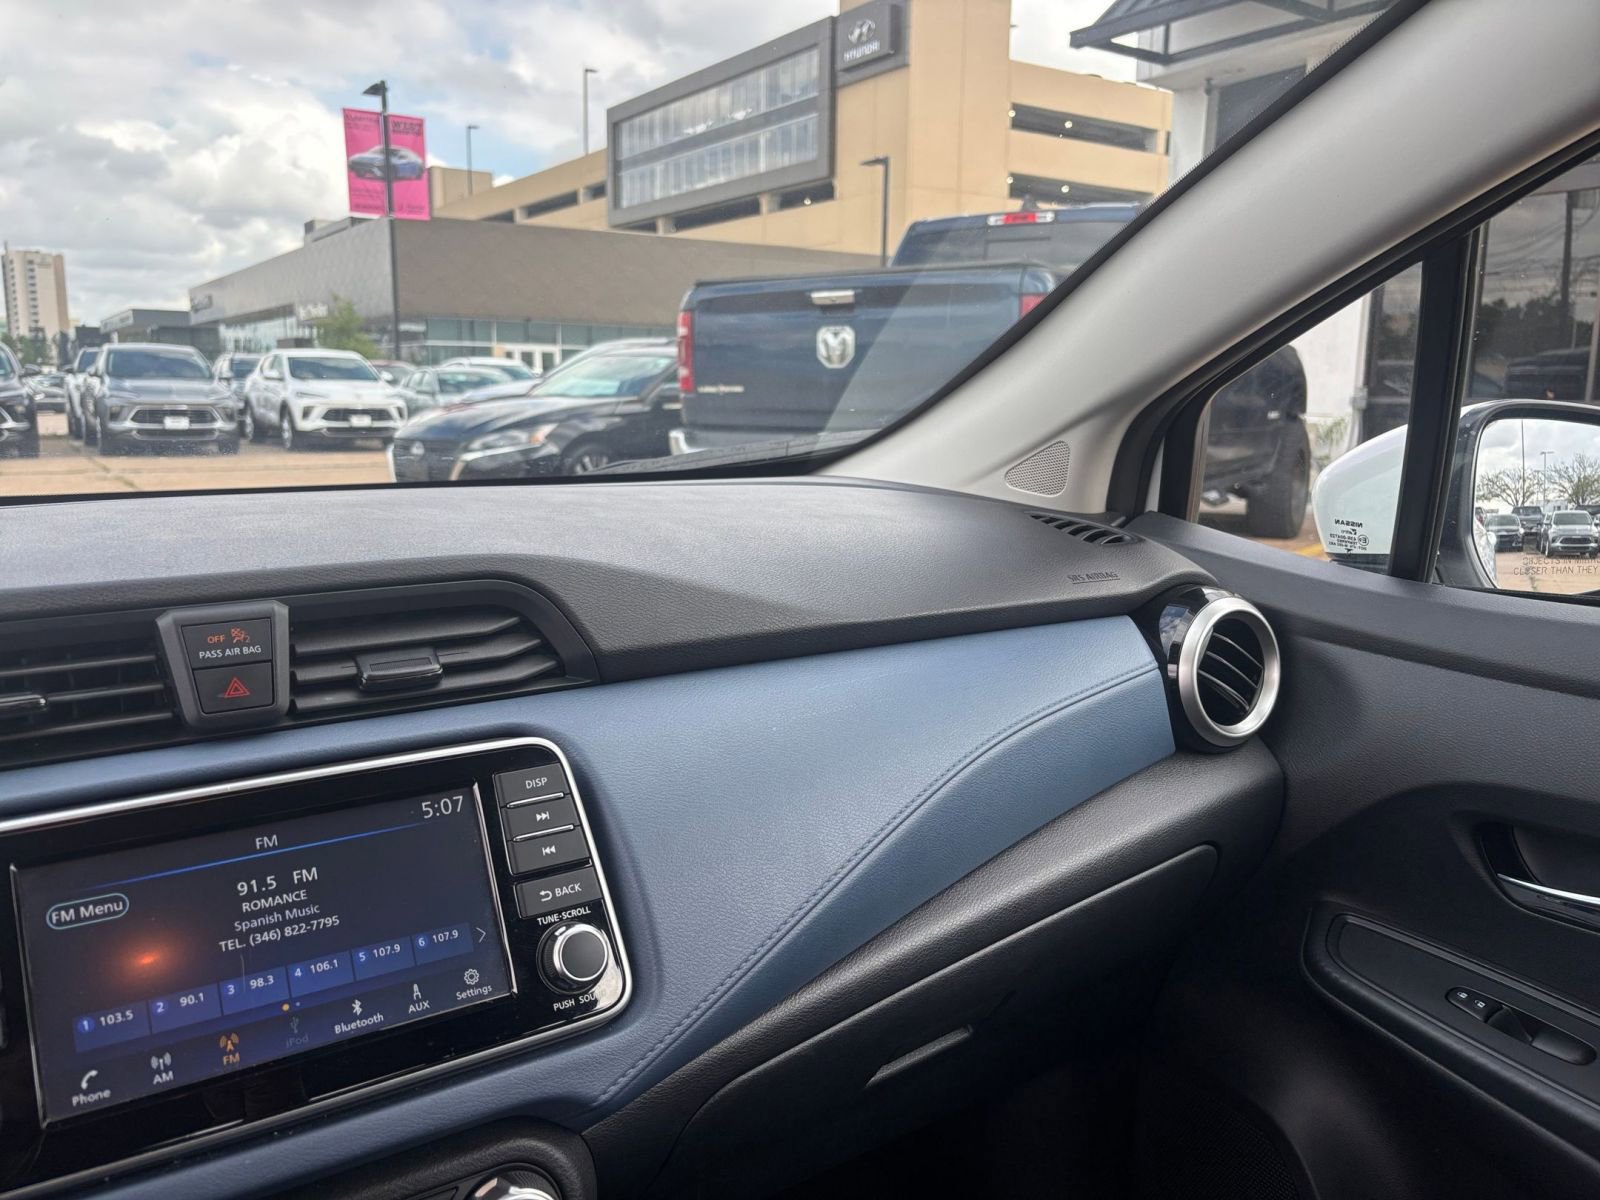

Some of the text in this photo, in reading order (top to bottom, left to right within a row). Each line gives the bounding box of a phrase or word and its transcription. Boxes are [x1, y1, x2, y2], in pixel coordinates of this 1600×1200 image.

[843, 40, 880, 62] HYUNDAI
[1523, 556, 1561, 566] OBJECTS
[1067, 571, 1119, 582] SRS AIRBAG
[1513, 565, 1598, 576] CLOSER THAN THEY
[207, 635, 225, 644] OFF
[199, 645, 262, 659] PASS AIR BAG
[525, 776, 548, 789] DISP
[421, 795, 464, 819] 5:07
[255, 834, 279, 850] FM
[237, 866, 319, 897] 91.5 FM
[555, 882, 582, 898] BACK
[242, 889, 308, 913] ROMANCE
[51, 899, 124, 924] FM Menu
[234, 903, 321, 933] Spanish Music
[218, 914, 340, 953] TEL. (346) 822-7795
[418, 930, 459, 947] 6 107.9
[359, 944, 401, 962] 5 107.9
[294, 960, 339, 978] 4 106.1
[228, 975, 275, 995] 3 98.3
[456, 984, 493, 1002] Settings
[156, 992, 205, 1013] 2 90.1
[408, 1000, 431, 1014] AUX
[553, 998, 576, 1012] PUSH
[83, 1009, 134, 1031] 1 103.5
[334, 1012, 385, 1035] Bluetooth
[286, 1033, 309, 1049] iPod
[223, 1052, 240, 1065] FM
[152, 1071, 174, 1085] AM
[72, 1088, 111, 1107] Phone
